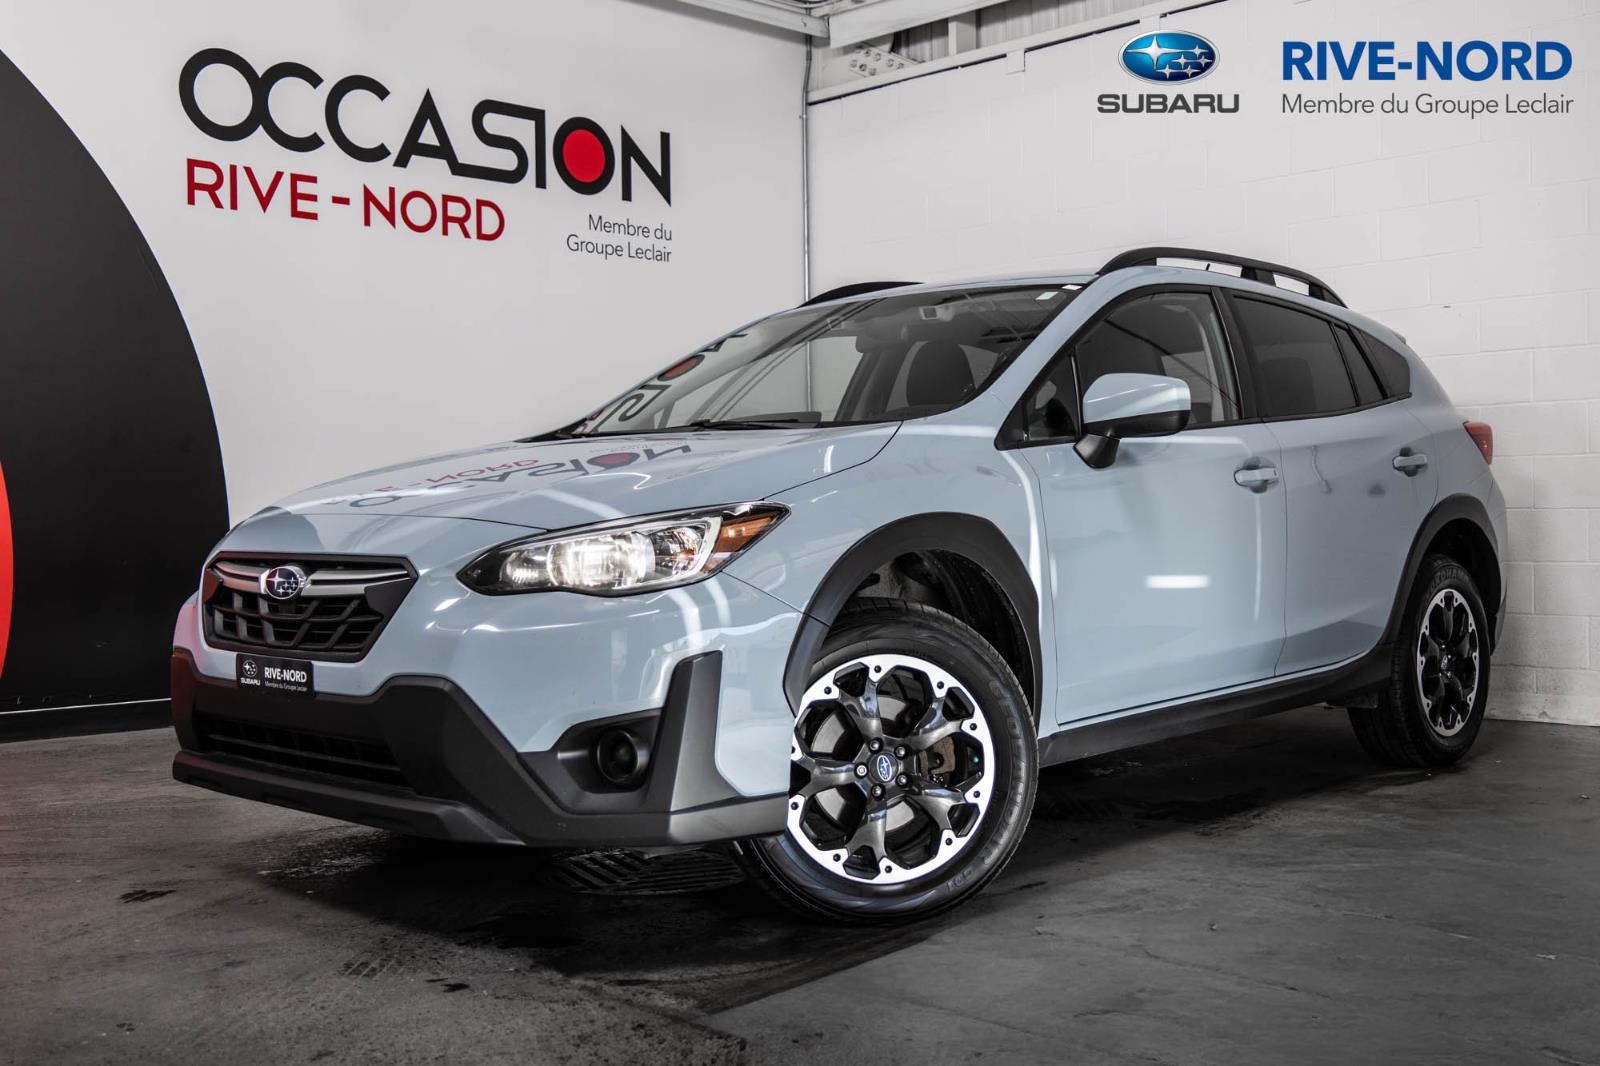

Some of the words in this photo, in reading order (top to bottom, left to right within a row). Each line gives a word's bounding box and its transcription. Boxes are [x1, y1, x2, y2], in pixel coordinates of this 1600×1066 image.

[179, 48, 671, 207] OCCASION
[588, 213, 650, 238] Membre
[653, 222, 672, 241] du
[566, 233, 624, 260] Groupe
[627, 241, 672, 262] Leclair
[240, 677, 261, 686] SUBARU
[264, 667, 307, 682] RIVE-NORD
